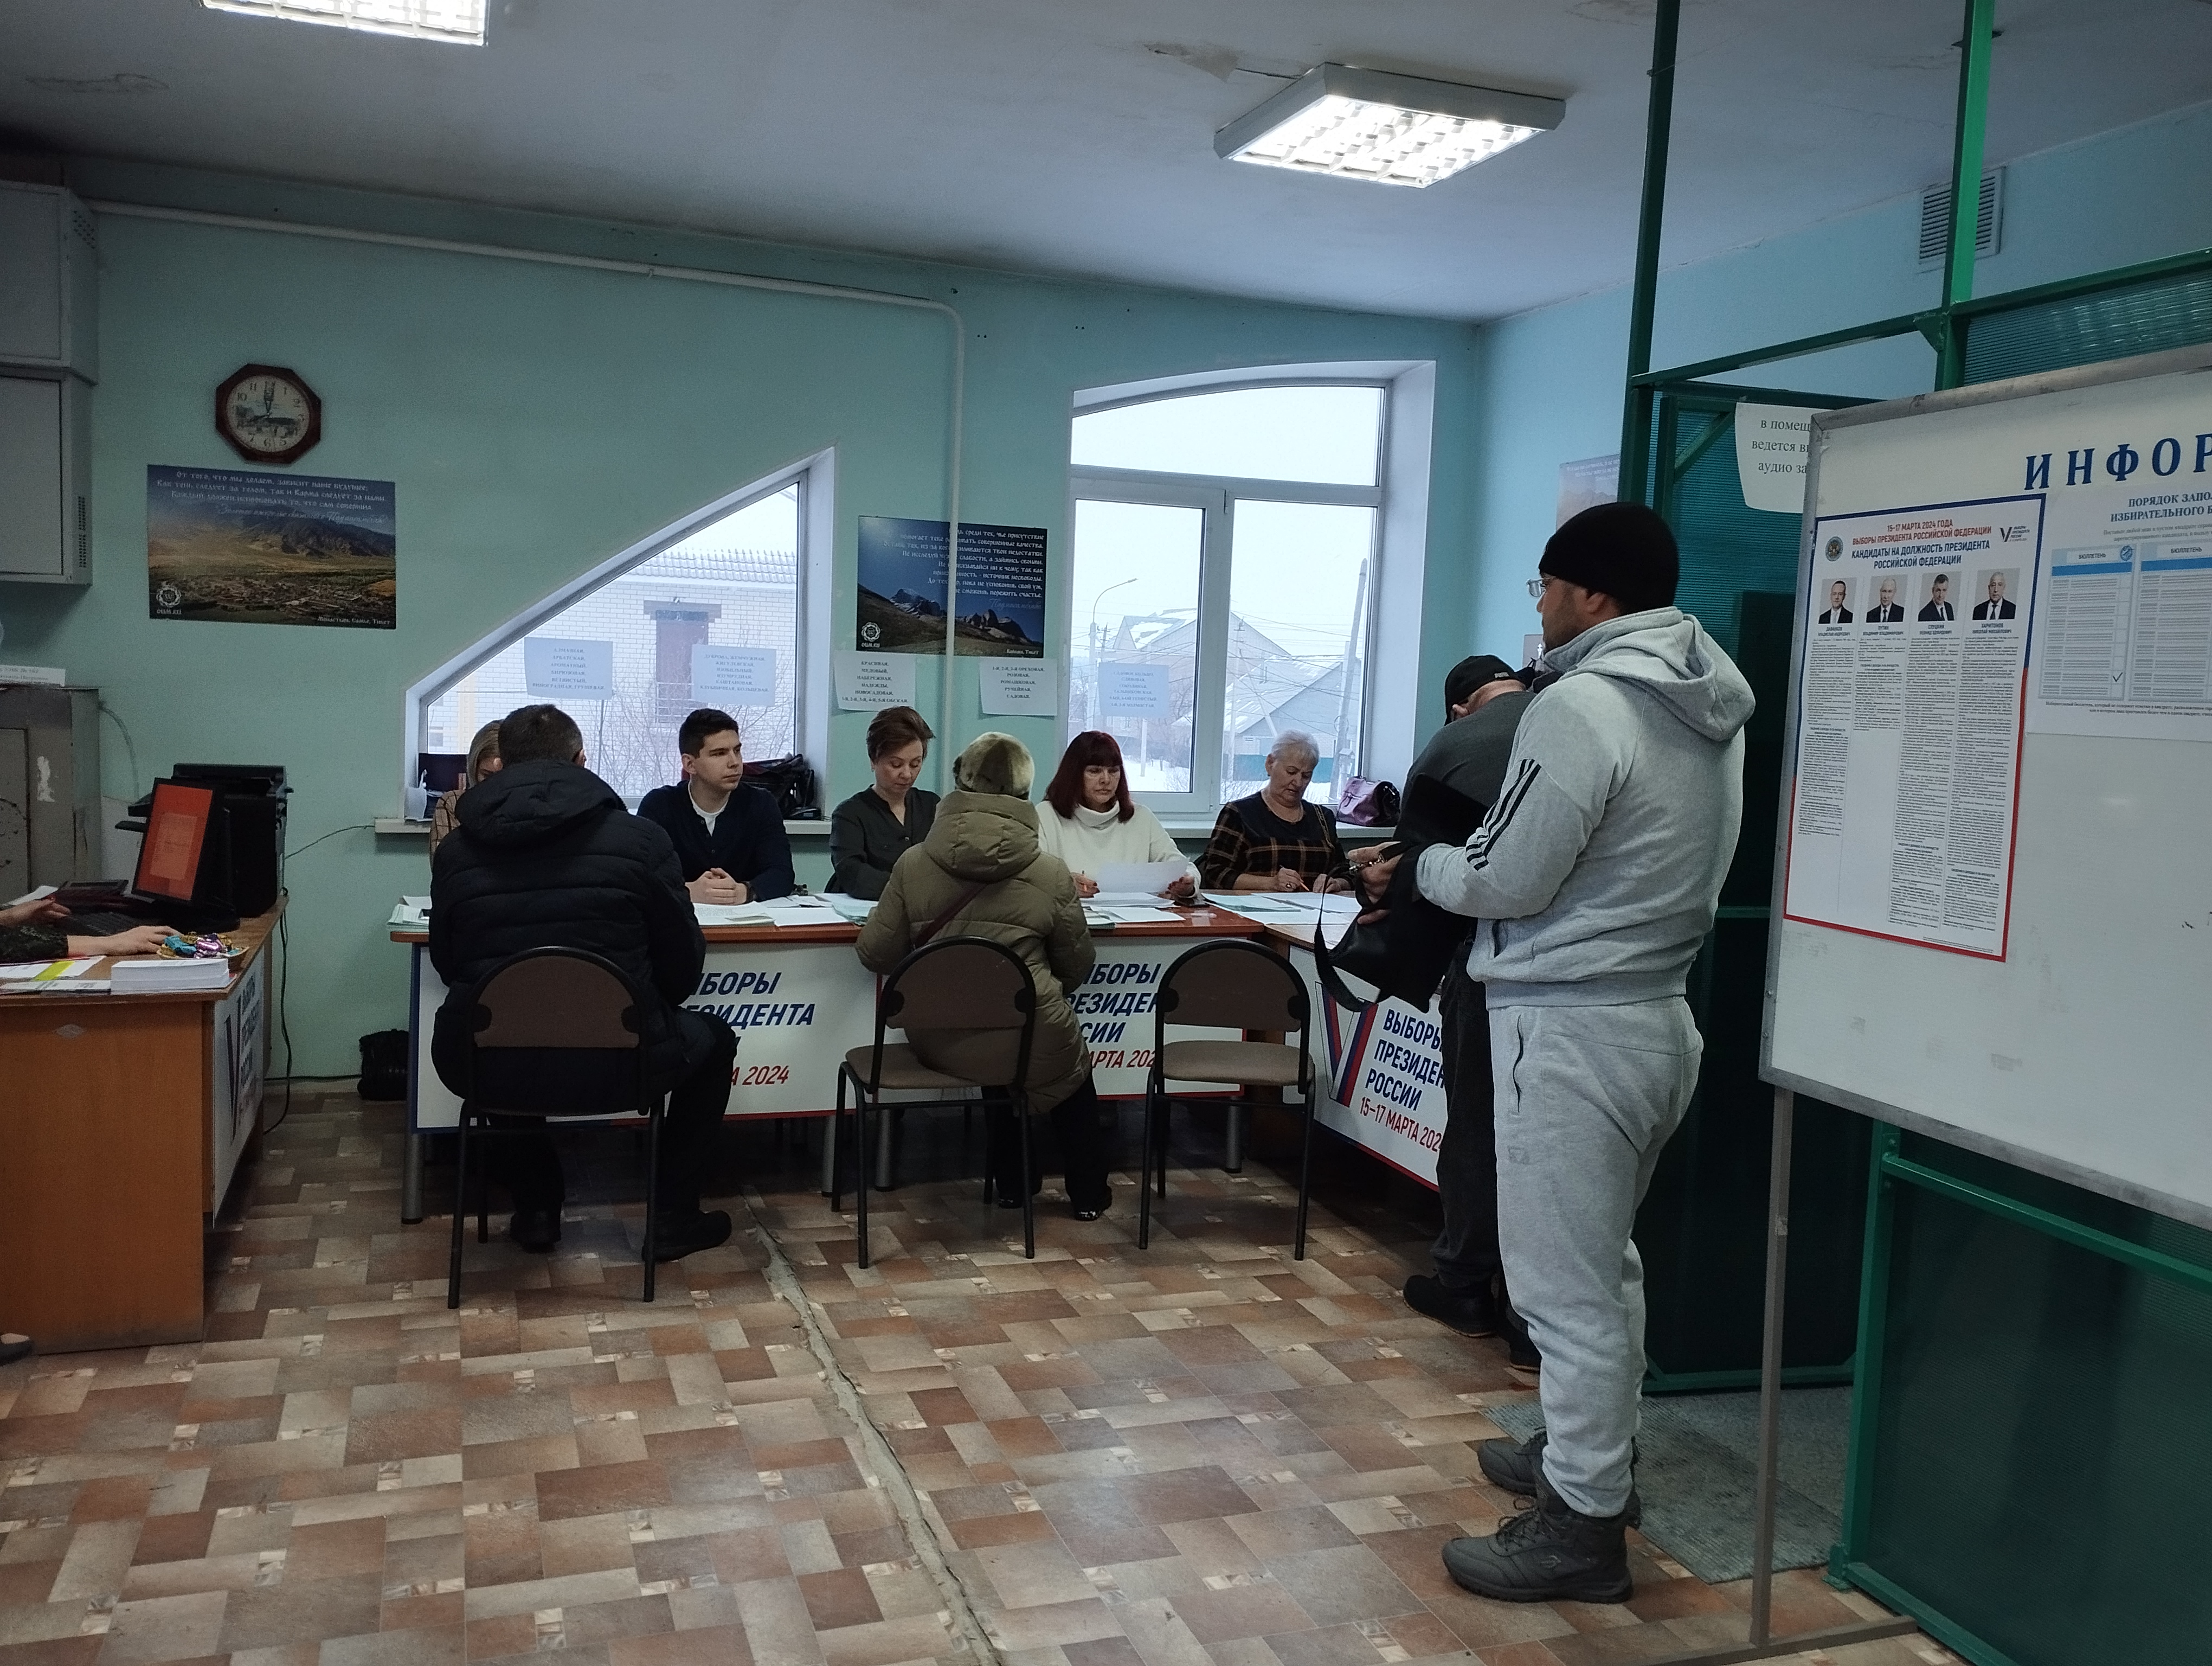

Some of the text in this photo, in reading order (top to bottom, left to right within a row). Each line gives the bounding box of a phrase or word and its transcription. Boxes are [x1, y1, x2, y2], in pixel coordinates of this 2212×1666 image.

[237, 392, 247, 401] 10
[293, 399, 300, 408] 2
[1761, 420, 1767, 428] в
[248, 432, 255, 442] 7
[263, 438, 272, 447] 6
[1752, 440, 1796, 452] ведется
[1758, 462, 1792, 475] аудио
[2129, 491, 2212, 508] ПОРЯДОК ЗАПО
[2111, 506, 2204, 522] ИЗБИРАТЕЛЬНОГО
[1901, 522, 1921, 531] МАРТА
[1922, 521, 1936, 529] 2024
[1937, 519, 1953, 528] ГОДА
[1853, 526, 1992, 545] ВЫБОРЫ ПРЕЗИДЕНТА РОССИЙСКОЙ ФЕДЕРАЦИИ
[1851, 540, 1990, 559] КАНДИДАТЫ НА ДОЛЖНОСТЬ ПРЕЗИДЕНТА
[1874, 555, 1962, 569] РОССИЙСКОЙ ФЕДЕРАЦИИ
[1083, 963, 1161, 984] БОРЫ
[694, 972, 782, 995] БОРЫ
[1374, 1039, 1445, 1088] ПРЕЗИДЕН
[742, 1066, 789, 1086] 2024
[1365, 1068, 1423, 1112] РОССИИ
[1385, 1109, 1419, 1143] МАРТА
[1419, 1126, 1442, 1152] 202
